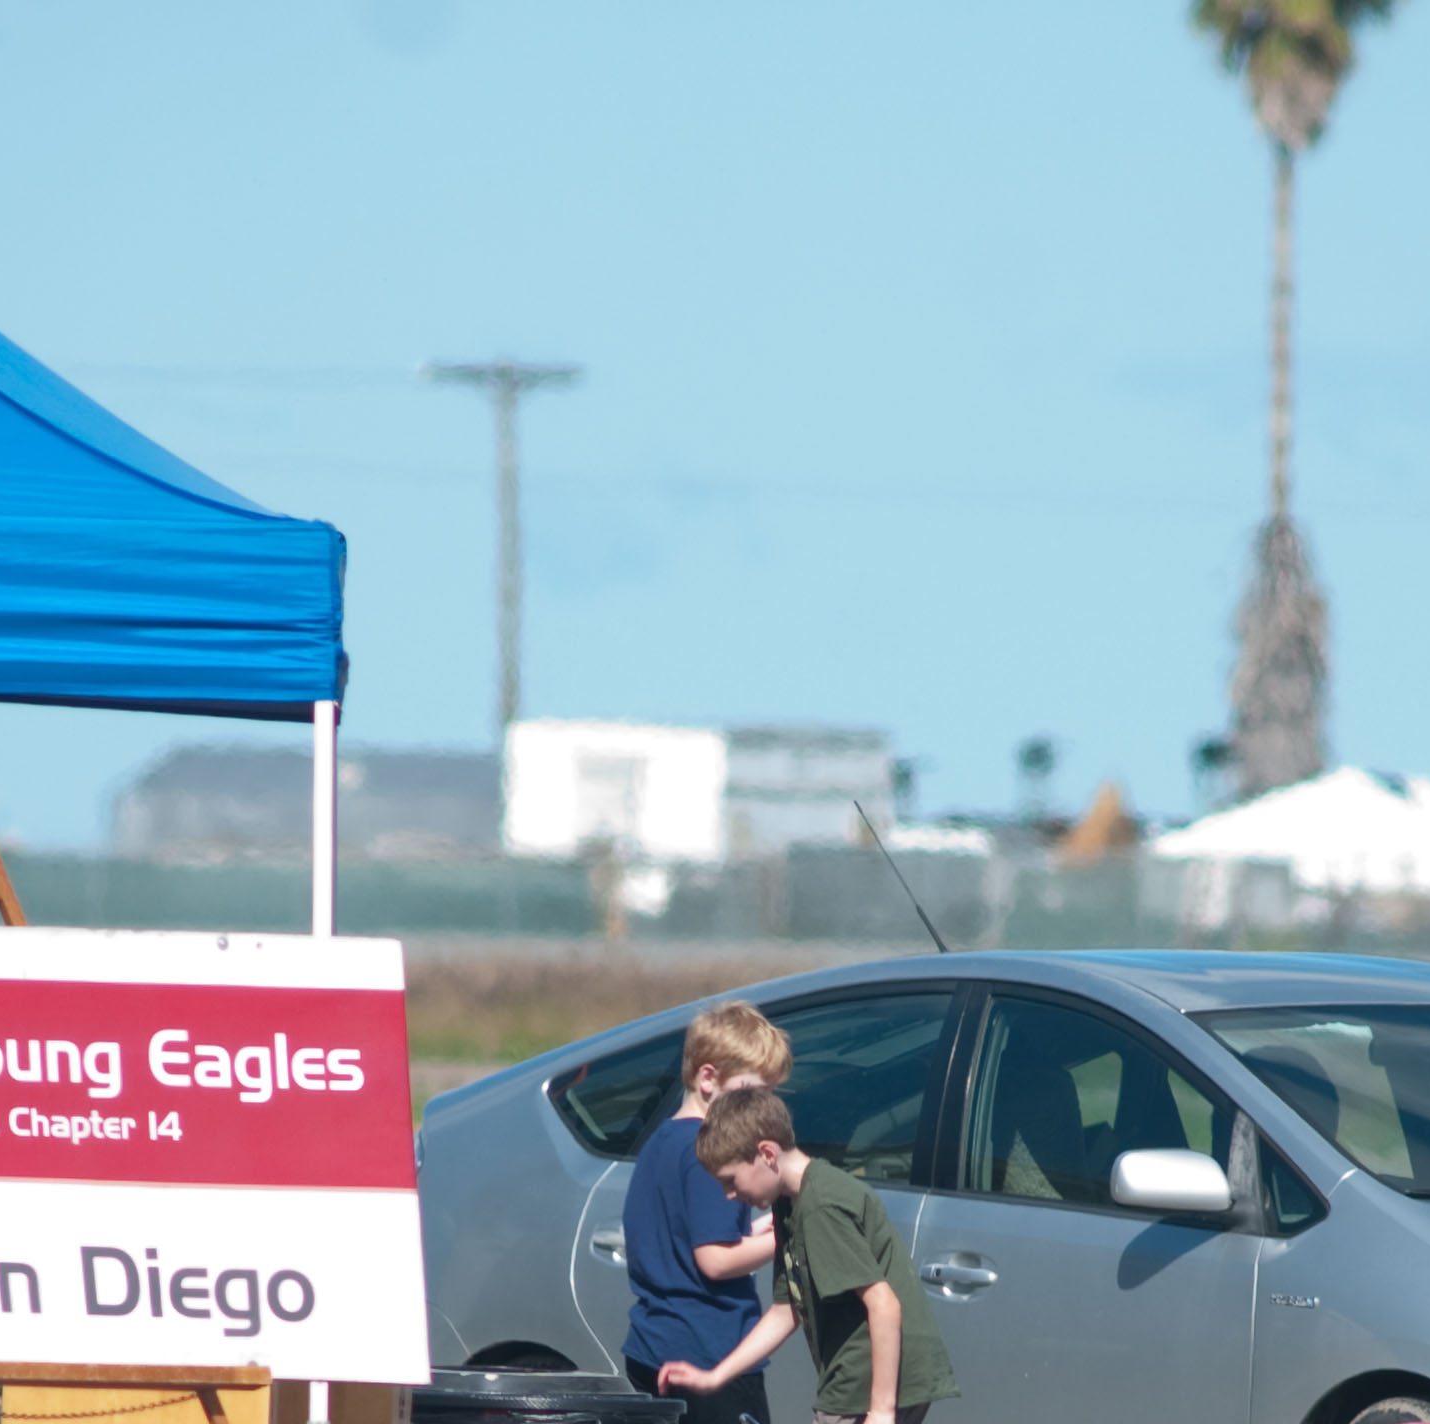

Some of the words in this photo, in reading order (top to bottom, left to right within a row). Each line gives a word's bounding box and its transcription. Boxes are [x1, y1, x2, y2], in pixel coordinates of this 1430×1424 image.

[148, 1029, 365, 1103] Eagles
[9, 1105, 136, 1144] Chapter
[148, 1109, 182, 1141] 14
[80, 1246, 315, 1337] Diego
